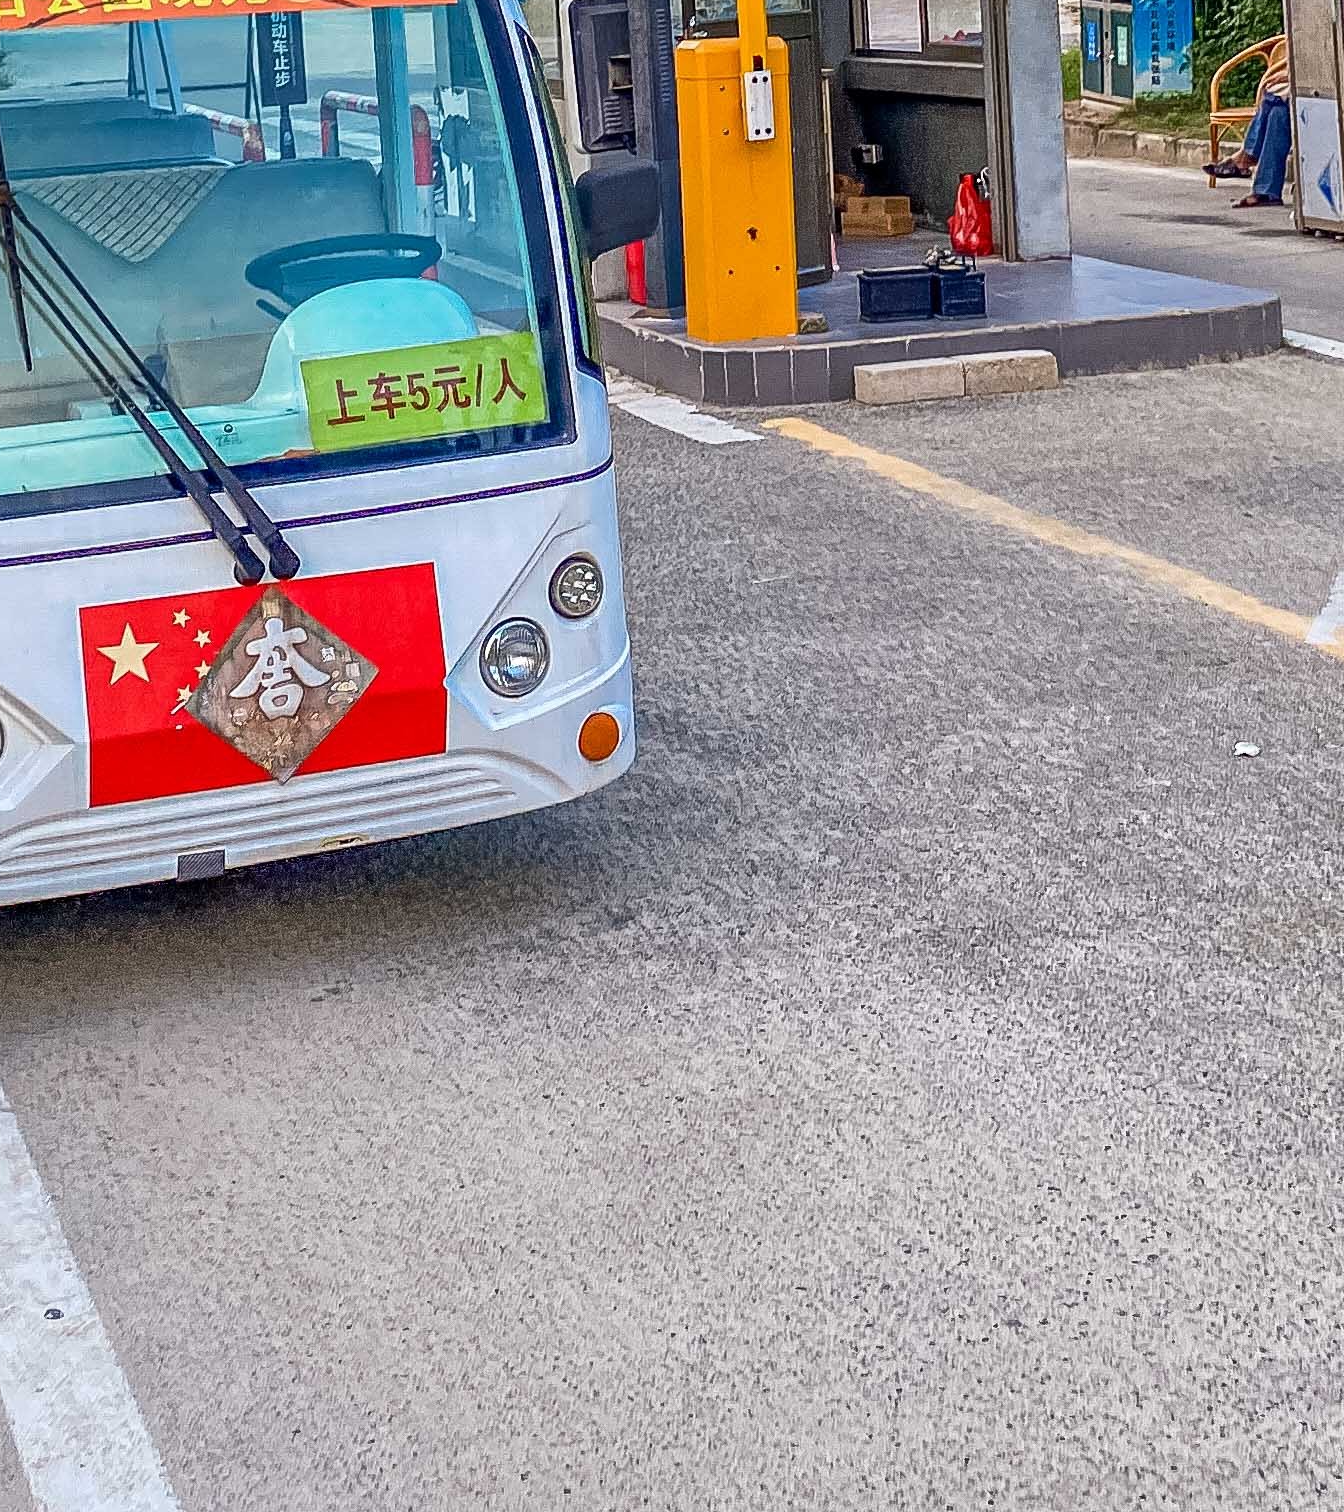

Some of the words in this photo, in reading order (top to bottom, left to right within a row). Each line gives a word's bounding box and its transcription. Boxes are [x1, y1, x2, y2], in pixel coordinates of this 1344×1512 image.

[271, 12, 291, 88] 机动车止步
[327, 358, 527, 426] 上车5元/人
